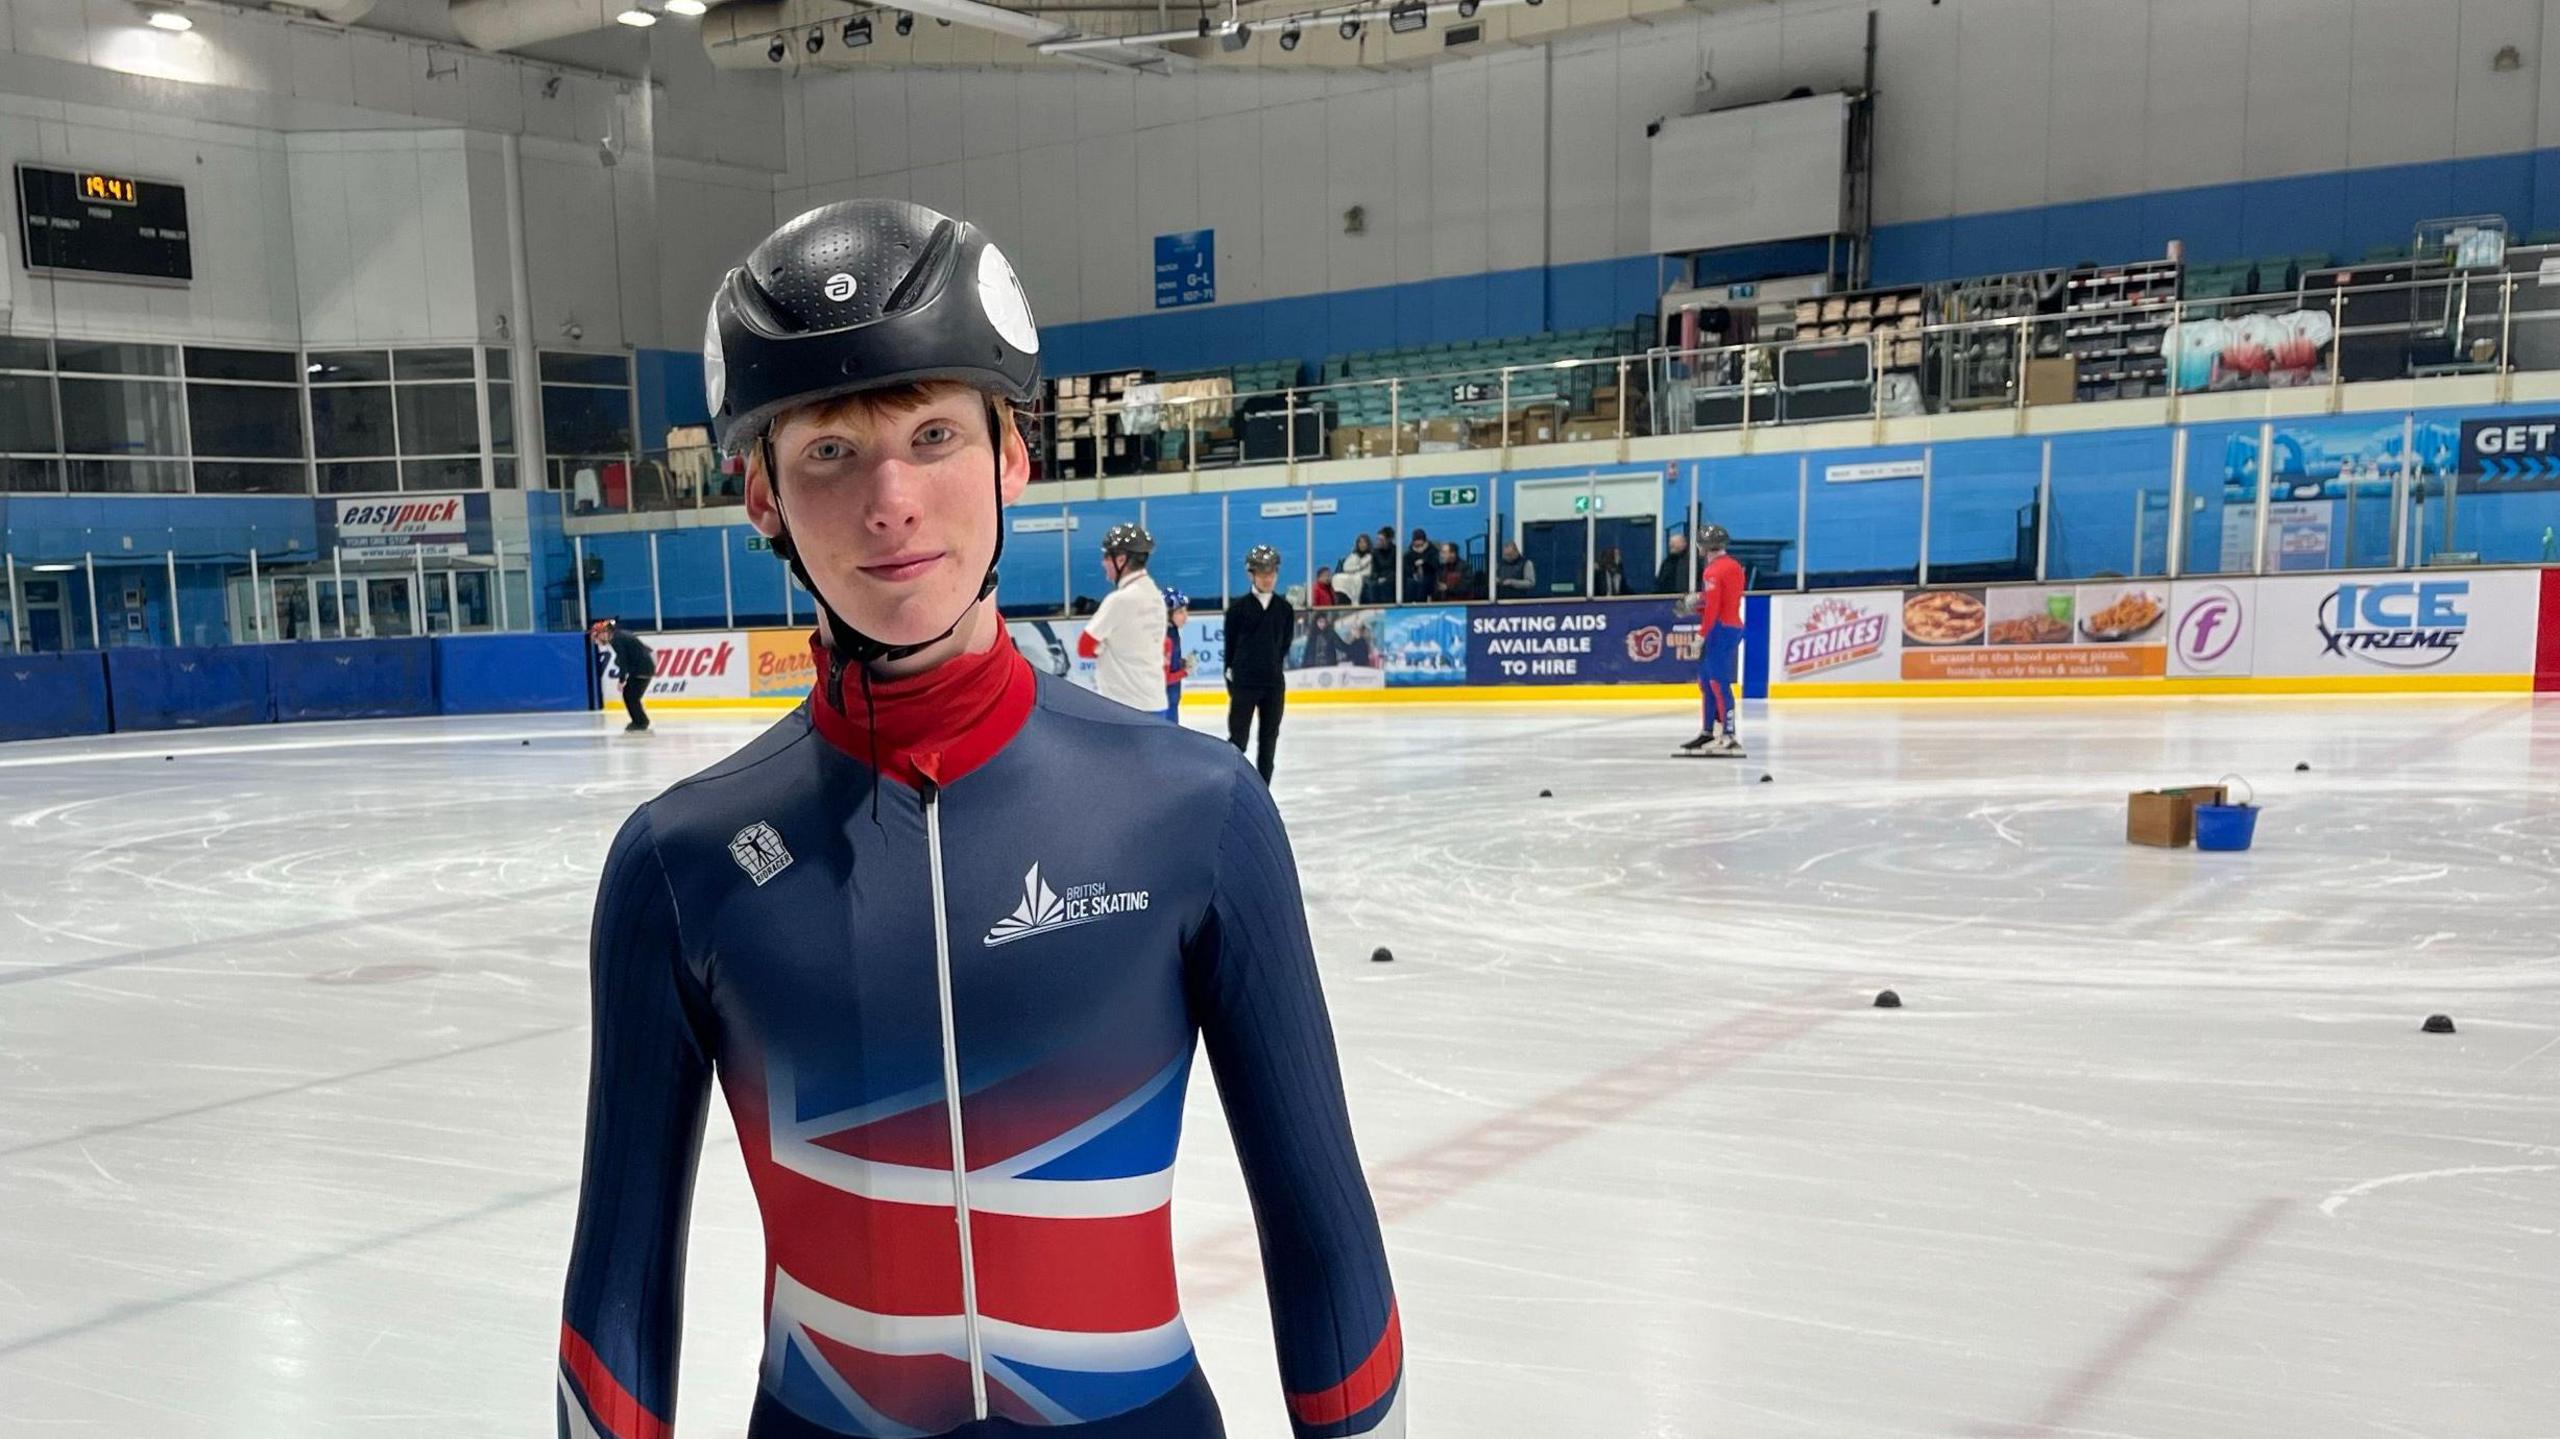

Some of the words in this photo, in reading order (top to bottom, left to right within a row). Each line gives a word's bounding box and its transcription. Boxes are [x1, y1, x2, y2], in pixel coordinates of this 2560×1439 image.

[1194, 252, 1203, 268] J
[2475, 423, 2556, 454] GET
[343, 499, 459, 533] easypuck
[2336, 580, 2470, 629] ICE
[1202, 624, 1226, 642] Le
[1473, 615, 1556, 633] SKATING
[1561, 614, 1607, 631] AIDS
[1487, 637, 1591, 655] AVAILABLE
[1788, 617, 1880, 663] STRIKES
[2317, 626, 2464, 657] XTREME
[1501, 660, 1526, 675] TO
[1532, 659, 1577, 675] HIRE
[1930, 652, 1975, 665] Located
[1978, 652, 1988, 663] in
[1992, 651, 2009, 663] the
[2013, 650, 2042, 662] bowl
[1997, 664, 2024, 676] curly
[2028, 664, 2052, 675] fries
[2055, 664, 2066, 675] &
[2069, 663, 2108, 675] snacks
[755, 854, 791, 884] BIORACER
[1066, 881, 1106, 901] BRITISH
[1066, 898, 1089, 920] ICE
[1091, 890, 1149, 916] SKATING
